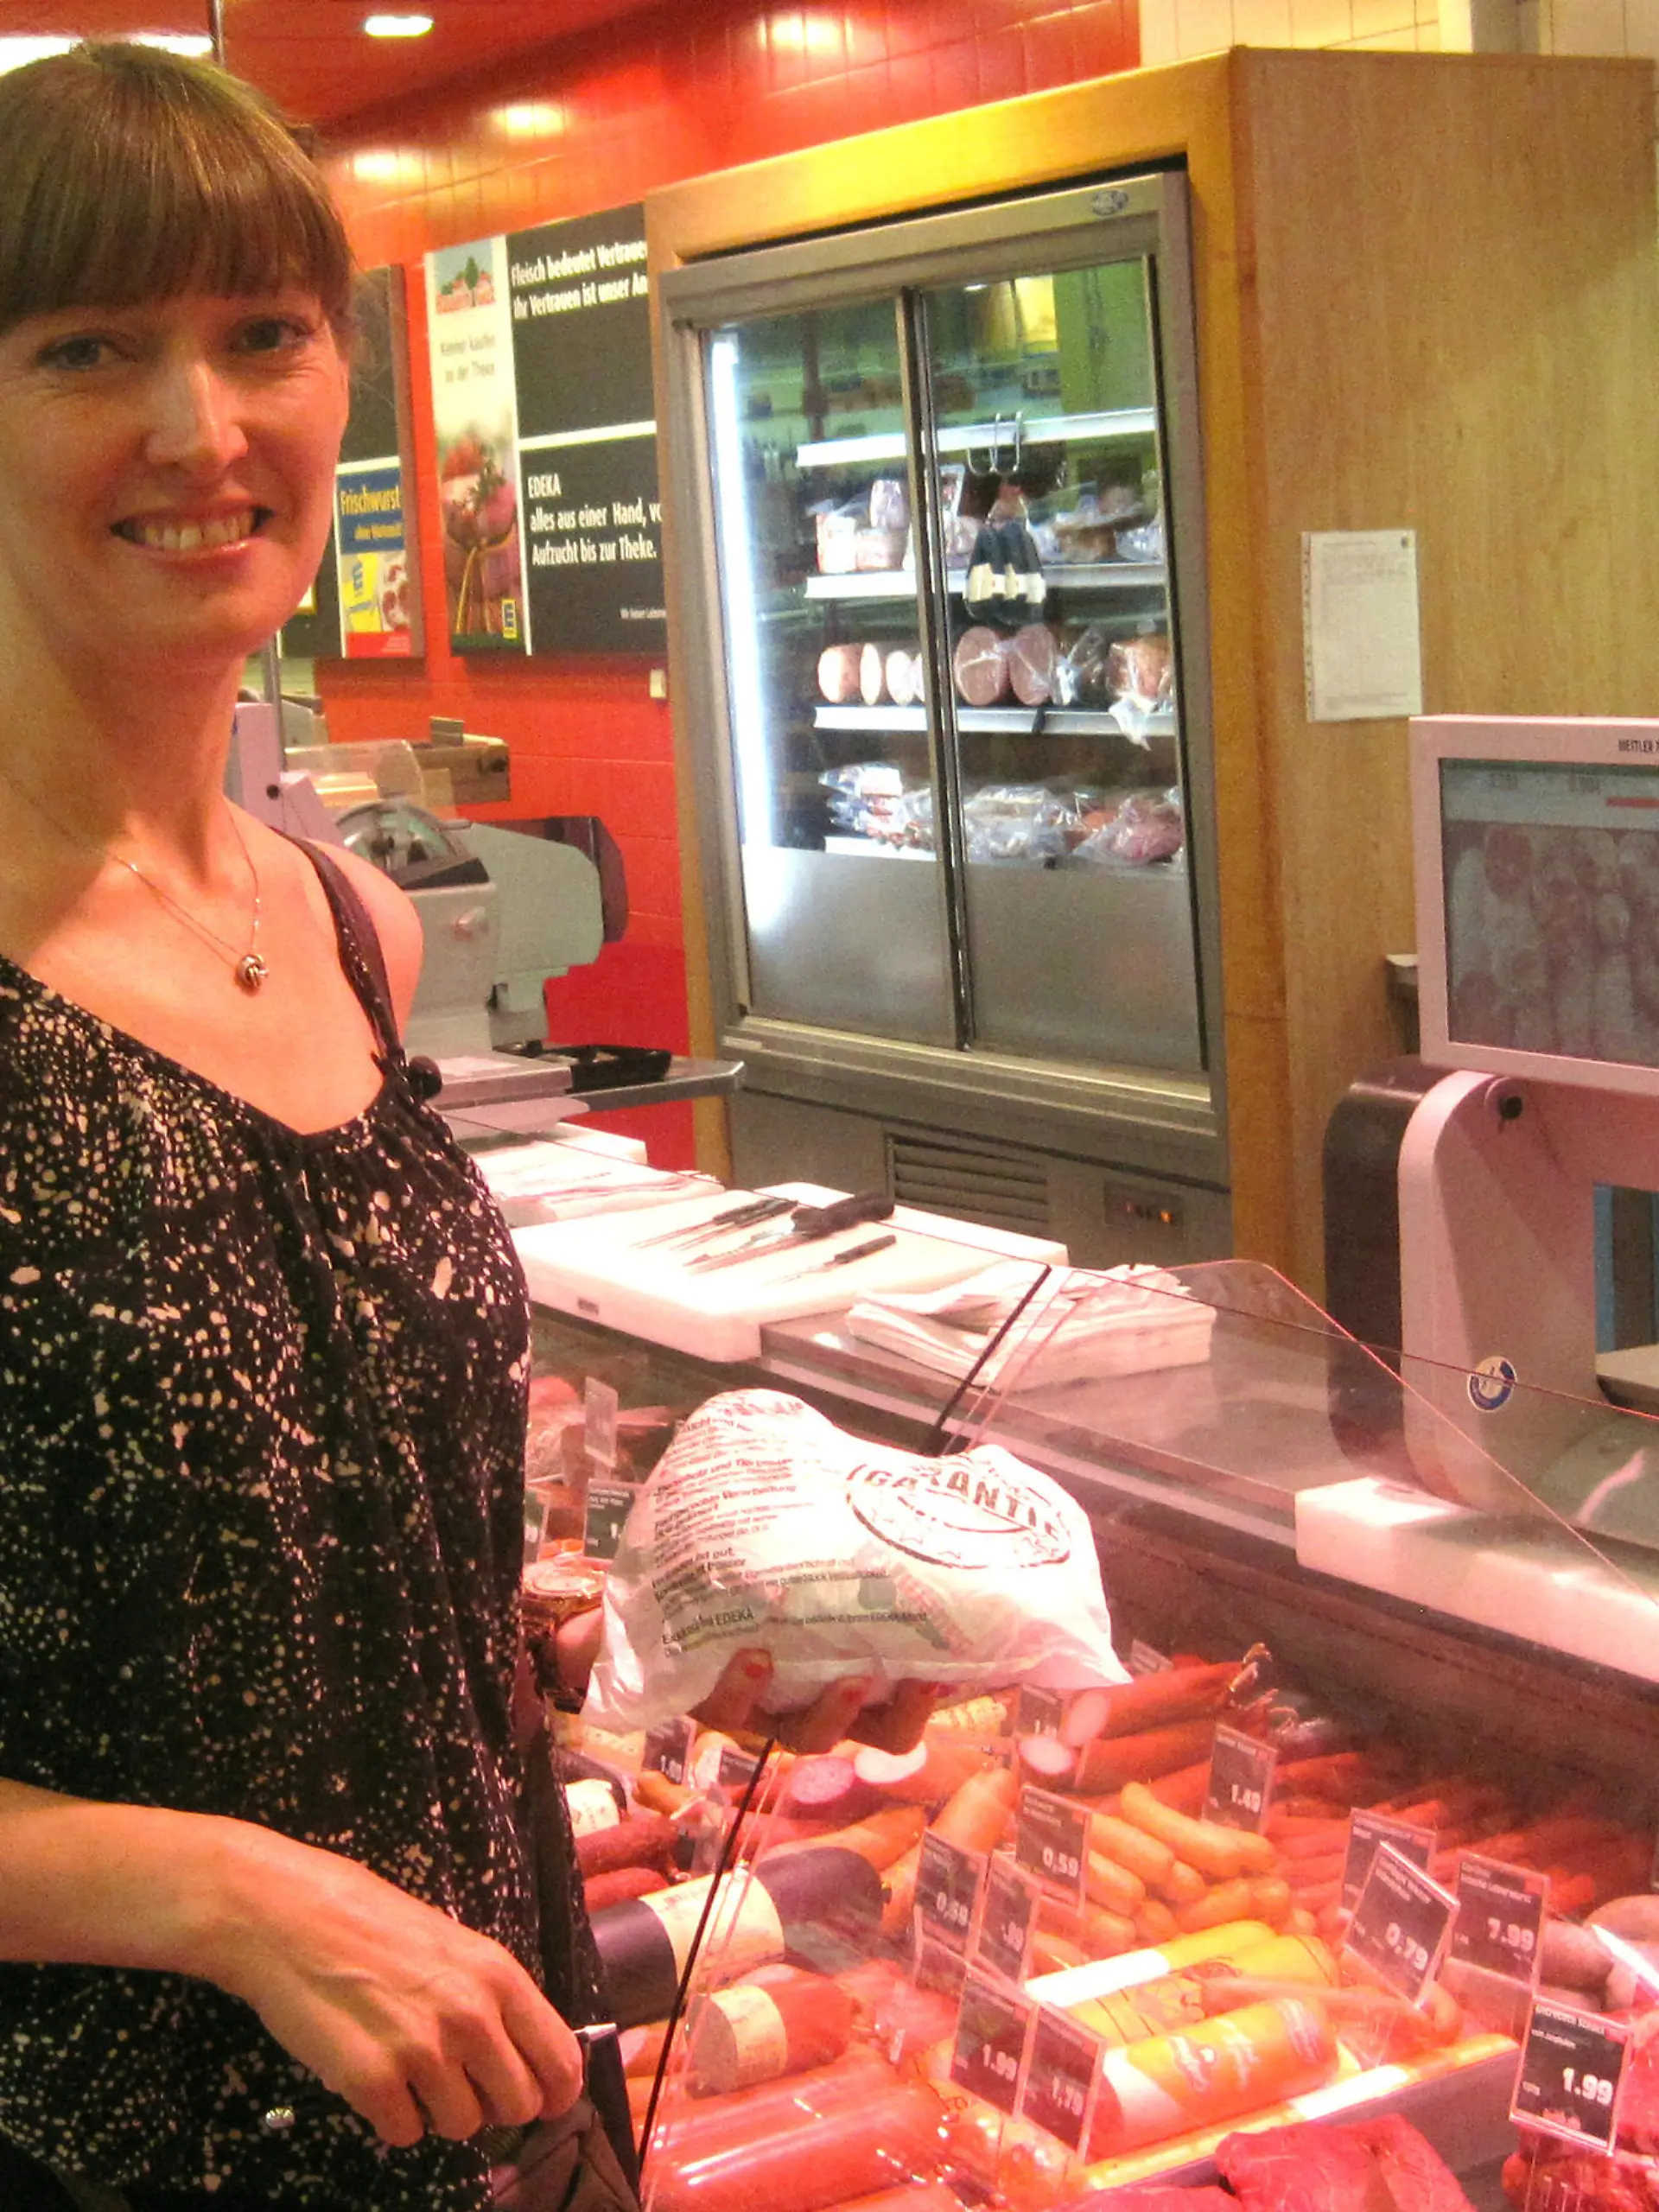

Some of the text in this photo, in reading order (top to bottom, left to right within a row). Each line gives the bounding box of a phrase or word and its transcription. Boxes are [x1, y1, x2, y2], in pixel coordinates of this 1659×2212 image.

[511, 257, 545, 287] Fleisch
[546, 248, 596, 280] bedeutet
[513, 296, 529, 320] Ihr
[529, 289, 581, 317] Vertrauen
[582, 282, 597, 307] ist
[598, 277, 629, 303] unser
[528, 473, 561, 499] EDEKA
[530, 506, 555, 532] alles
[557, 510, 576, 530] aus
[578, 504, 607, 528] einer
[613, 497, 646, 529] Hand,
[532, 532, 657, 566] Aufzucht bis zur Theke.
[714, 1606, 755, 1626] EDEKA
[1562, 2067, 1613, 2106] 1.99
